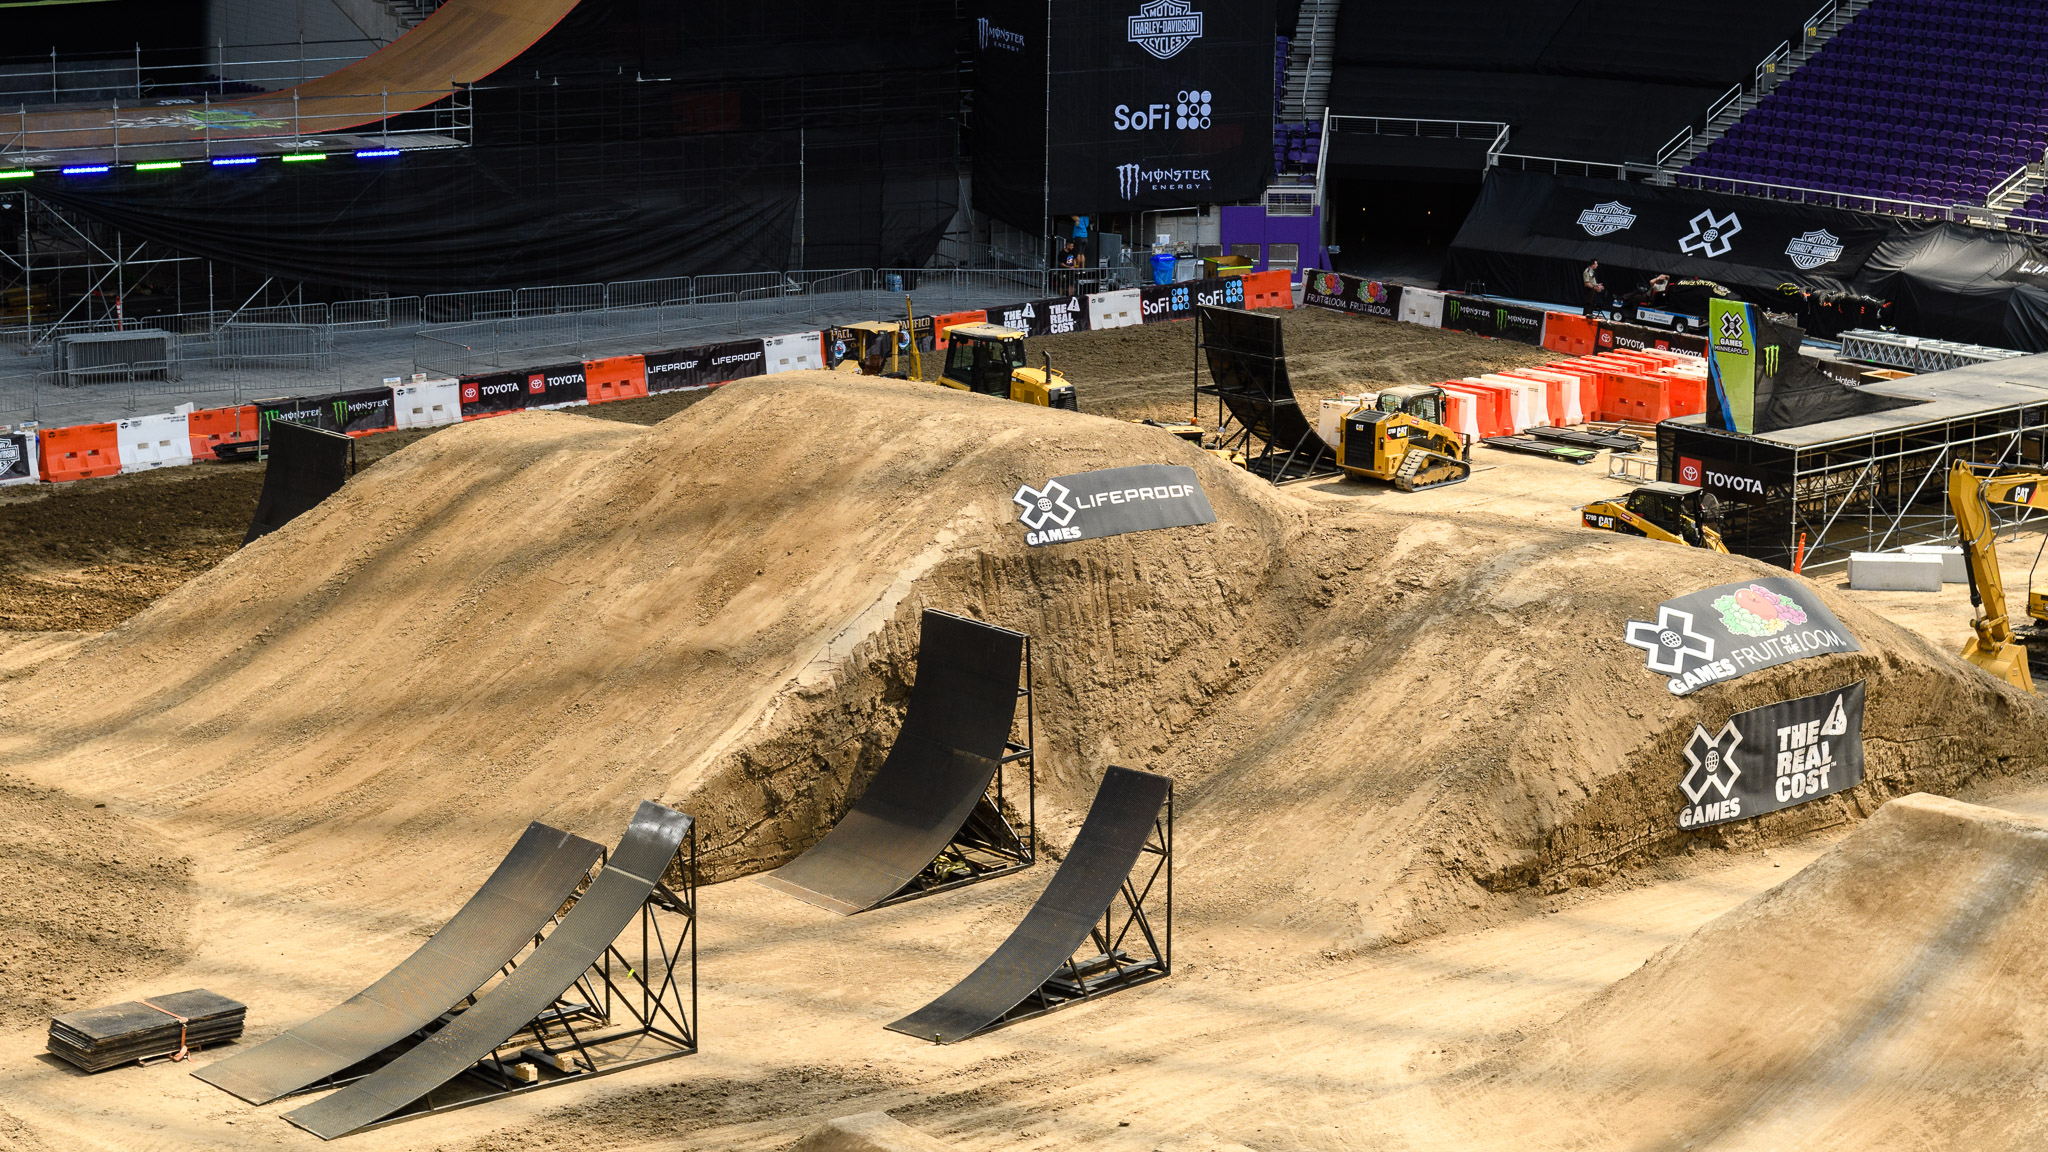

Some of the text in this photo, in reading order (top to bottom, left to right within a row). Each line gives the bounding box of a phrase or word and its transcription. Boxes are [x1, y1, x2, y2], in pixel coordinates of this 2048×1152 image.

[1149, 3, 1182, 17] MOTOR
[1134, 19, 1196, 35] HARLEY-DAVIDSON
[1807, 26, 1816, 37] 118
[988, 27, 1025, 46] MONSTER
[1149, 36, 1182, 53] CYCLES
[1766, 63, 1775, 73] 118
[1114, 103, 1170, 131] SoFi
[1141, 168, 1211, 183] MONSTER
[1600, 206, 1623, 215] MOTOR
[1584, 213, 1630, 225] HARLEY-DAVIDSON
[1807, 235, 1832, 246] MOTOR
[1197, 290, 1224, 306] SoFi
[1307, 293, 1324, 303] FRUIT
[1049, 304, 1067, 314] THE
[1142, 297, 1170, 315] SoFi
[1350, 301, 1369, 312] FRUIT
[1460, 305, 1491, 318] MONSTER
[1003, 309, 1022, 321] THE
[1050, 312, 1074, 325] REAL
[1507, 314, 1539, 327] MONSTER
[1003, 319, 1030, 329] REAL
[1050, 322, 1074, 334] COST
[1615, 336, 1645, 350] TOYOTA
[1714, 344, 1749, 355] MINNEAPOLIS
[1719, 338, 1743, 347] GAMES
[711, 352, 762, 366] LIFEPROOF
[648, 360, 699, 374] LIFEPROOF
[547, 373, 584, 387] TOYOTA
[482, 382, 519, 396] TOYOTA
[348, 399, 389, 412] MONSTER
[280, 409, 322, 421] MONSTER
[1397, 425, 1408, 438] CAT
[1705, 470, 1764, 495] TOYOTA
[1076, 484, 1195, 509] LIFEPROOF
[2014, 486, 2029, 503] CAT
[1598, 515, 1614, 528] CAT
[1026, 526, 1082, 546] GAMES
[1780, 634, 1793, 646] OF
[1731, 638, 1784, 669] FRUIT
[1784, 643, 1801, 655] THE
[1667, 658, 1737, 695] GAMES
[1776, 719, 1820, 751] THE
[1776, 741, 1832, 777] REAL
[1775, 764, 1831, 803] COST
[1679, 797, 1741, 827] GAMES
